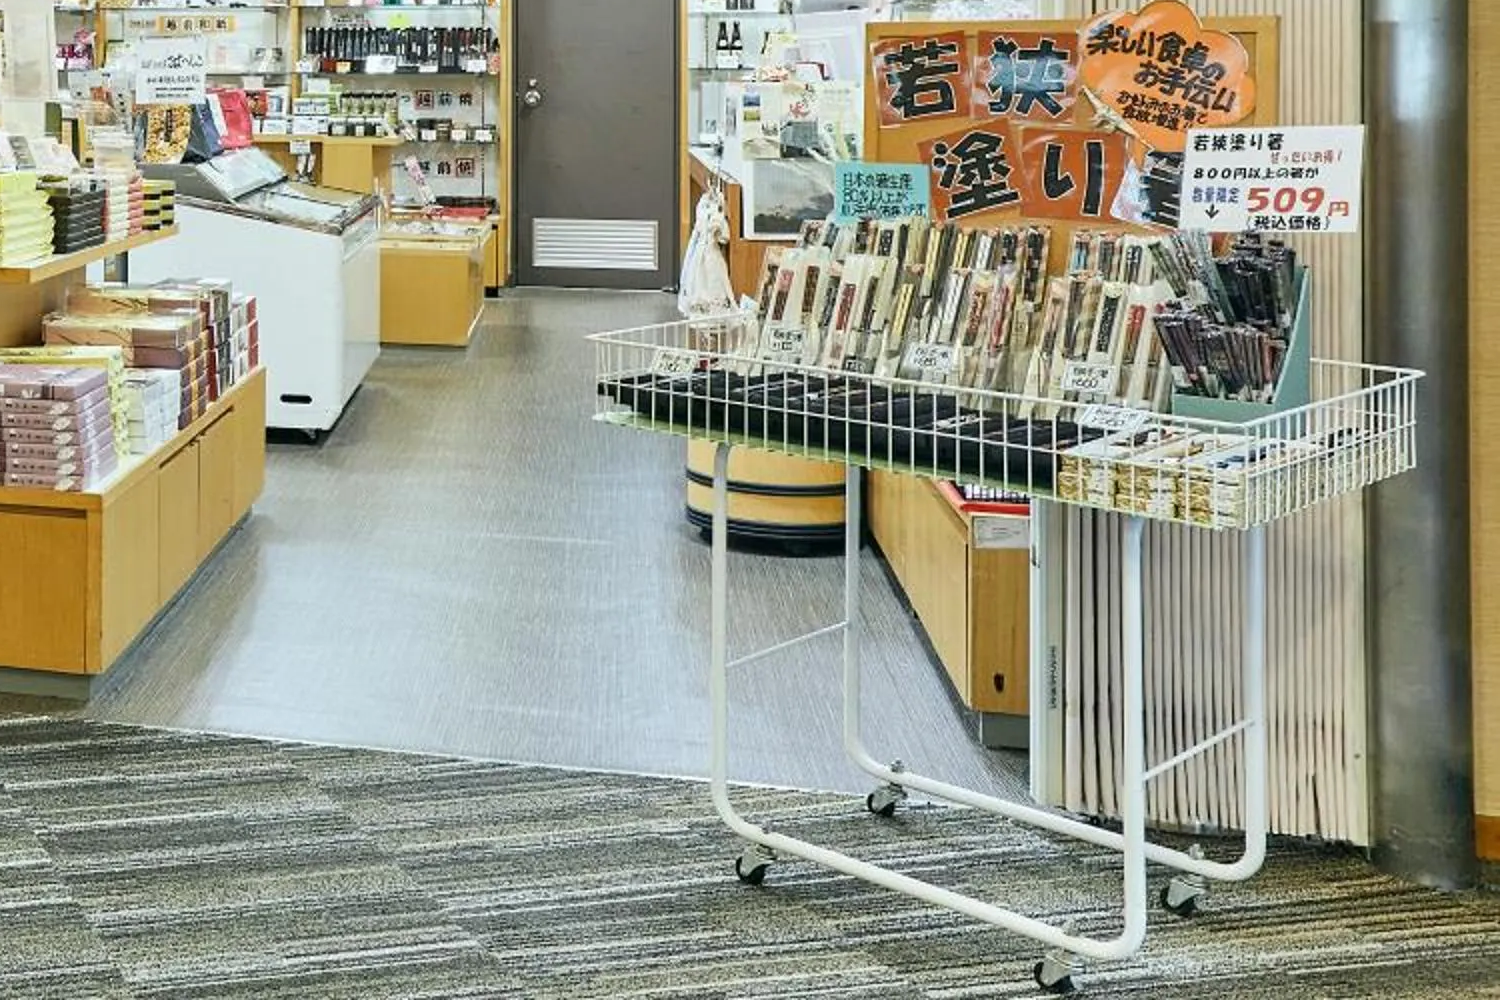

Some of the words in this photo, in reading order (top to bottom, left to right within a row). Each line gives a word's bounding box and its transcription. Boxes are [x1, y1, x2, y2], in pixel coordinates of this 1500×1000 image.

[885, 37, 1069, 118] 若狭
[1087, 24, 1226, 80] 楽しい食卓の
[1134, 61, 1236, 112] お手伝い
[1194, 133, 1284, 151] 若狭塗り箸
[1247, 187, 1349, 216] 509円
